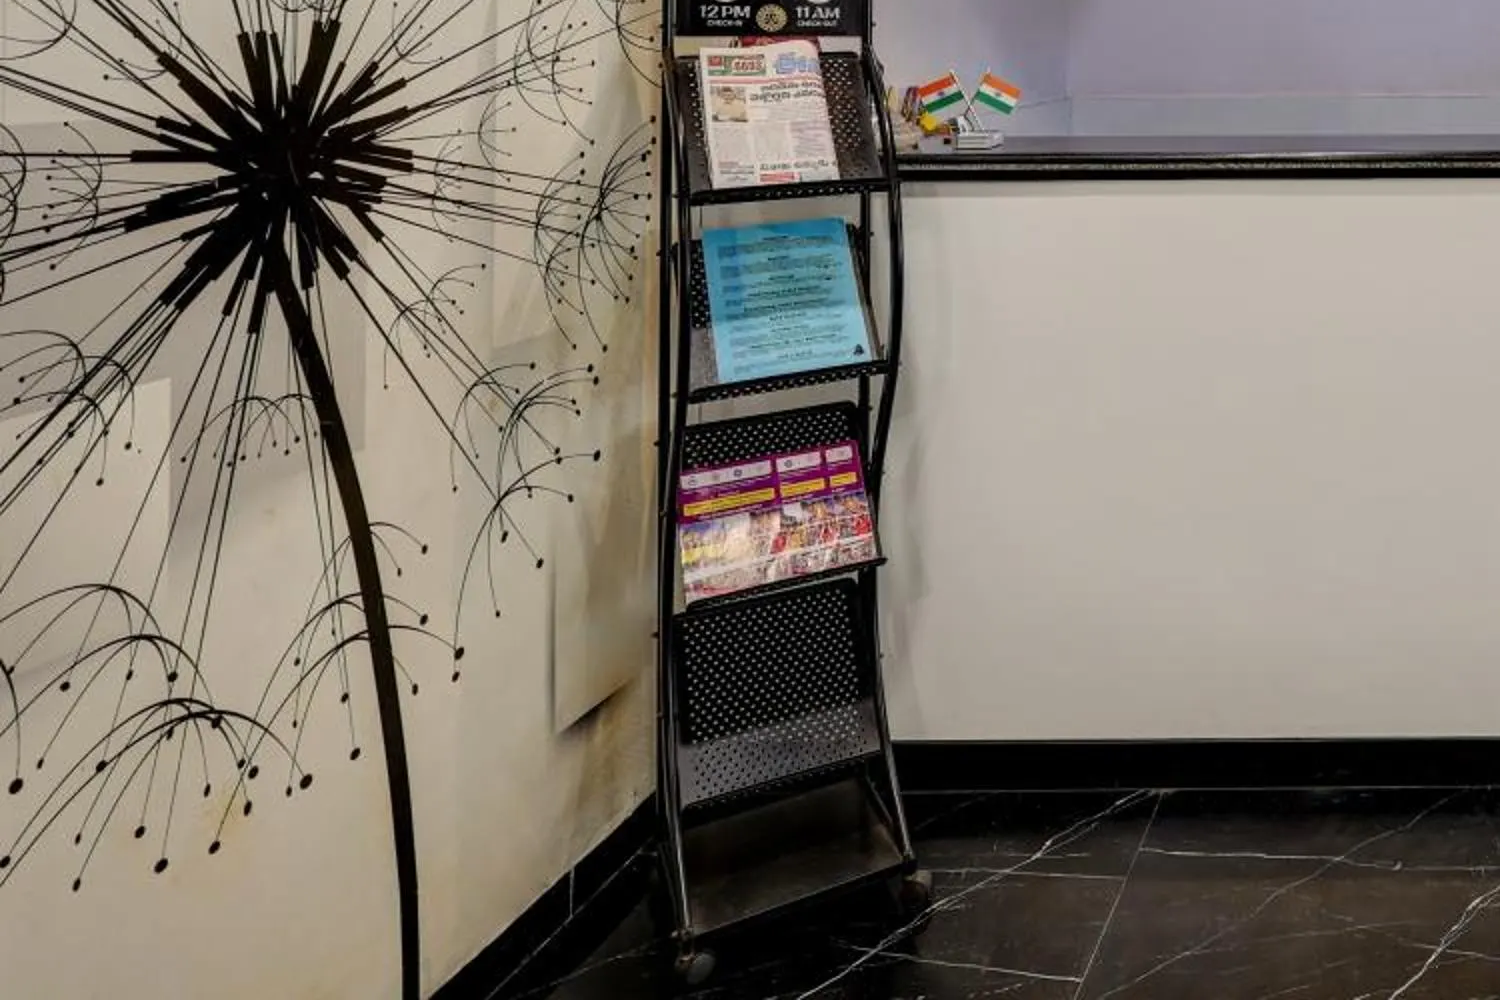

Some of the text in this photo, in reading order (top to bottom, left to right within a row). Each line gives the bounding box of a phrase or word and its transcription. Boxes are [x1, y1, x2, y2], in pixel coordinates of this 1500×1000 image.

[700, 5, 751, 18] 12 PM
[795, 6, 840, 19] 11 AM
